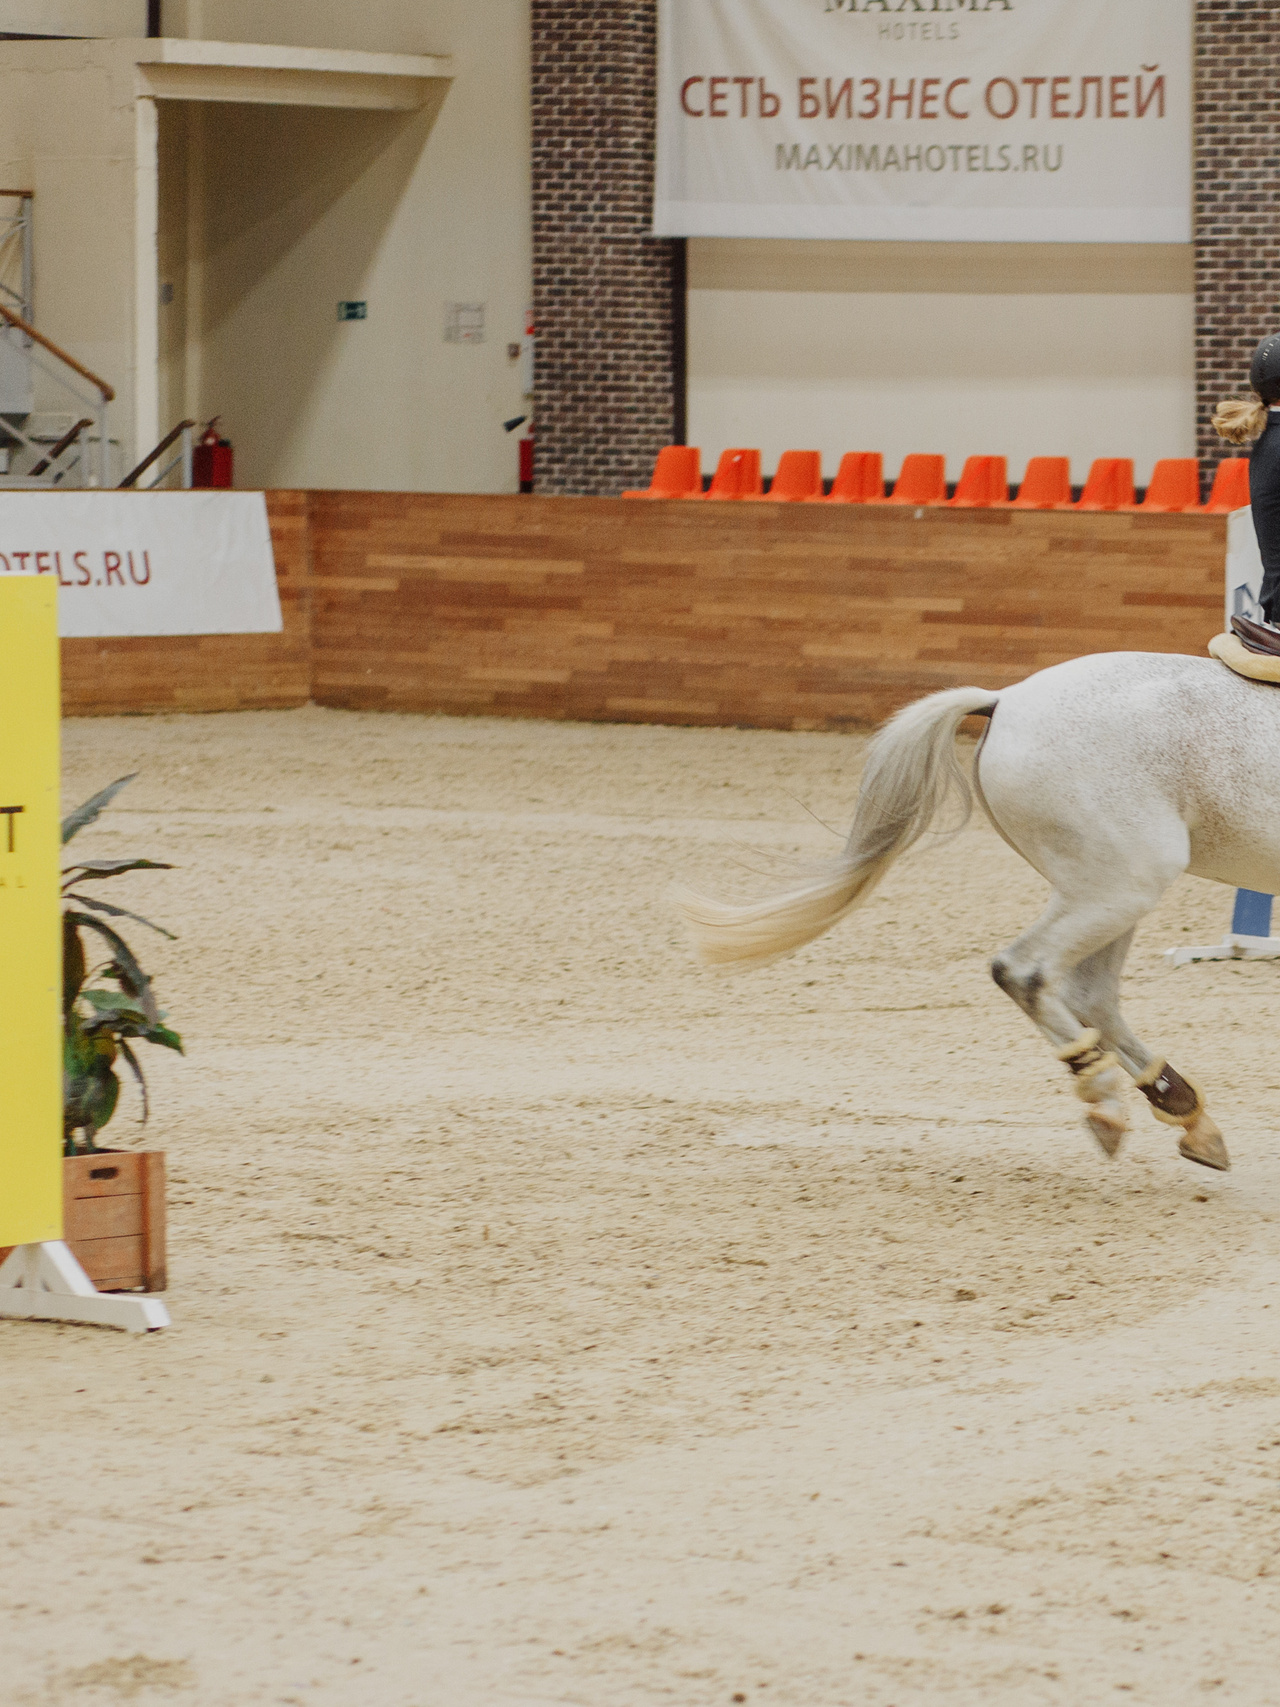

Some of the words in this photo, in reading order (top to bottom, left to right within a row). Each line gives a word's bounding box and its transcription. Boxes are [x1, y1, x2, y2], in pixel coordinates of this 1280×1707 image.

[878, 22, 959, 41] HOTELS
[680, 76, 781, 118] СЕТЬ
[798, 77, 971, 119] БИЗНЕС
[985, 64, 1166, 119] ОТЕЛЕЙ
[774, 144, 1065, 172] MAXIMAHOTELS.RU
[0, 551, 151, 587] TELS.RU
